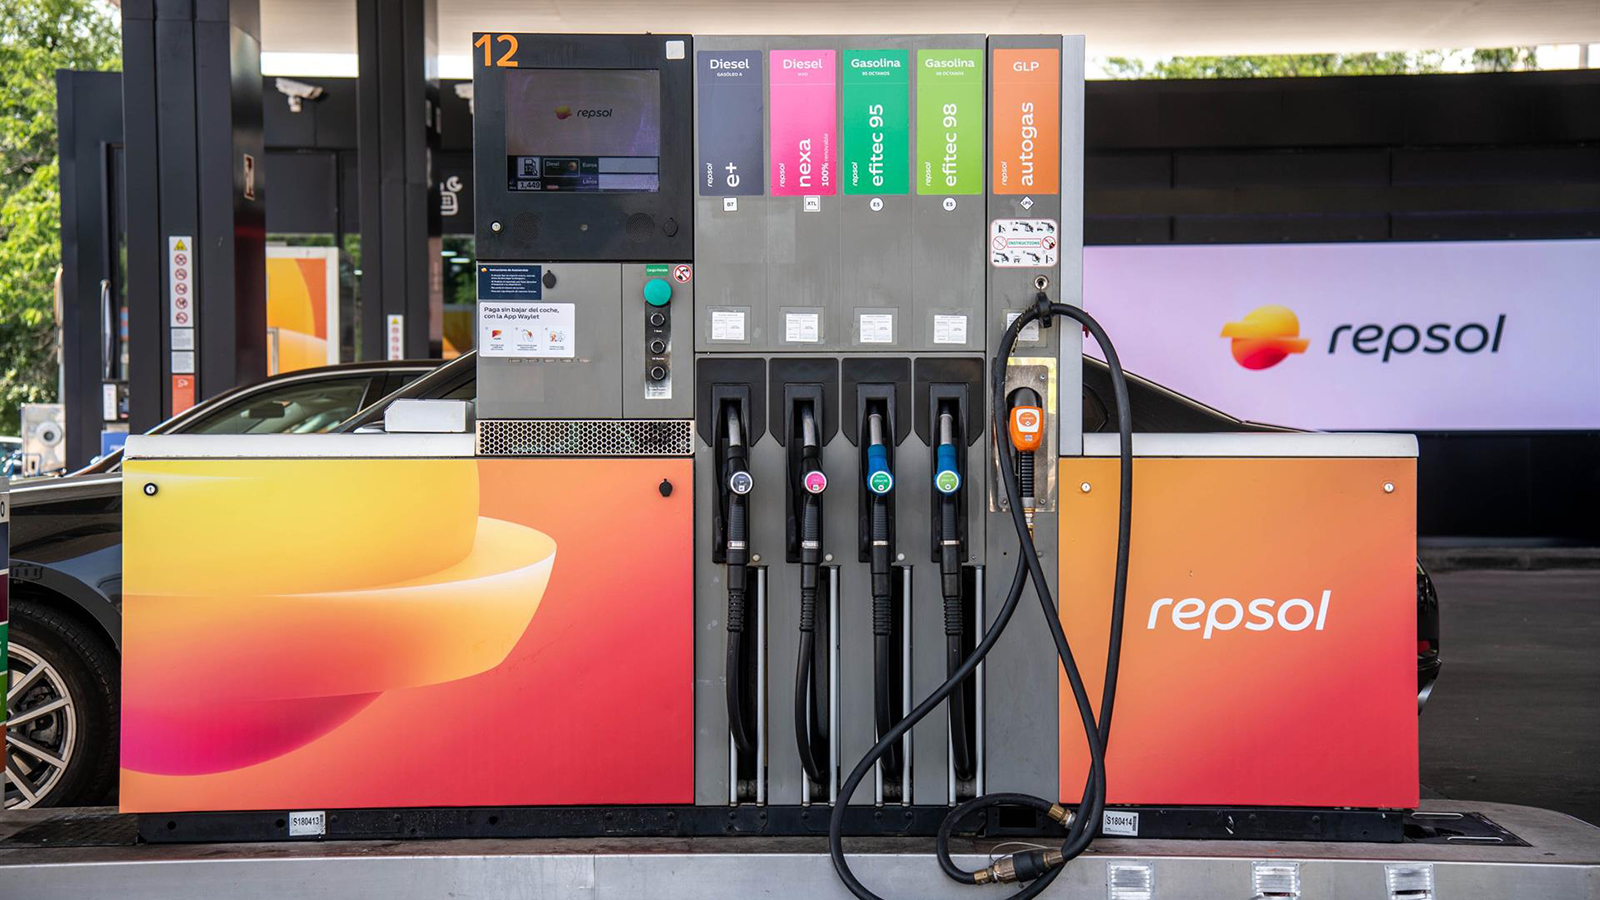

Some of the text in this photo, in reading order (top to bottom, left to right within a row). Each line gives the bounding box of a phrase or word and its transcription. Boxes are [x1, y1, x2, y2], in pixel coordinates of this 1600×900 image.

[474, 34, 519, 67] 12
[851, 58, 901, 68] Gasolina
[925, 58, 975, 68] Gasolina
[710, 58, 750, 69] Diesel
[783, 58, 823, 69] Diesel
[1013, 62, 1039, 72] GLP
[576, 108, 613, 118] repsol
[868, 104, 884, 186] efitec 95
[942, 103, 957, 186] efitec 98
[1020, 102, 1037, 186] autogas
[725, 162, 740, 187] e+
[800, 138, 811, 187] nexa
[821, 162, 829, 186] 100%
[851, 161, 859, 186] repsol
[924, 161, 932, 186] repsol
[484, 306, 500, 314] Paga
[1327, 313, 1507, 363] repsol
[1147, 589, 1332, 640] repsol
